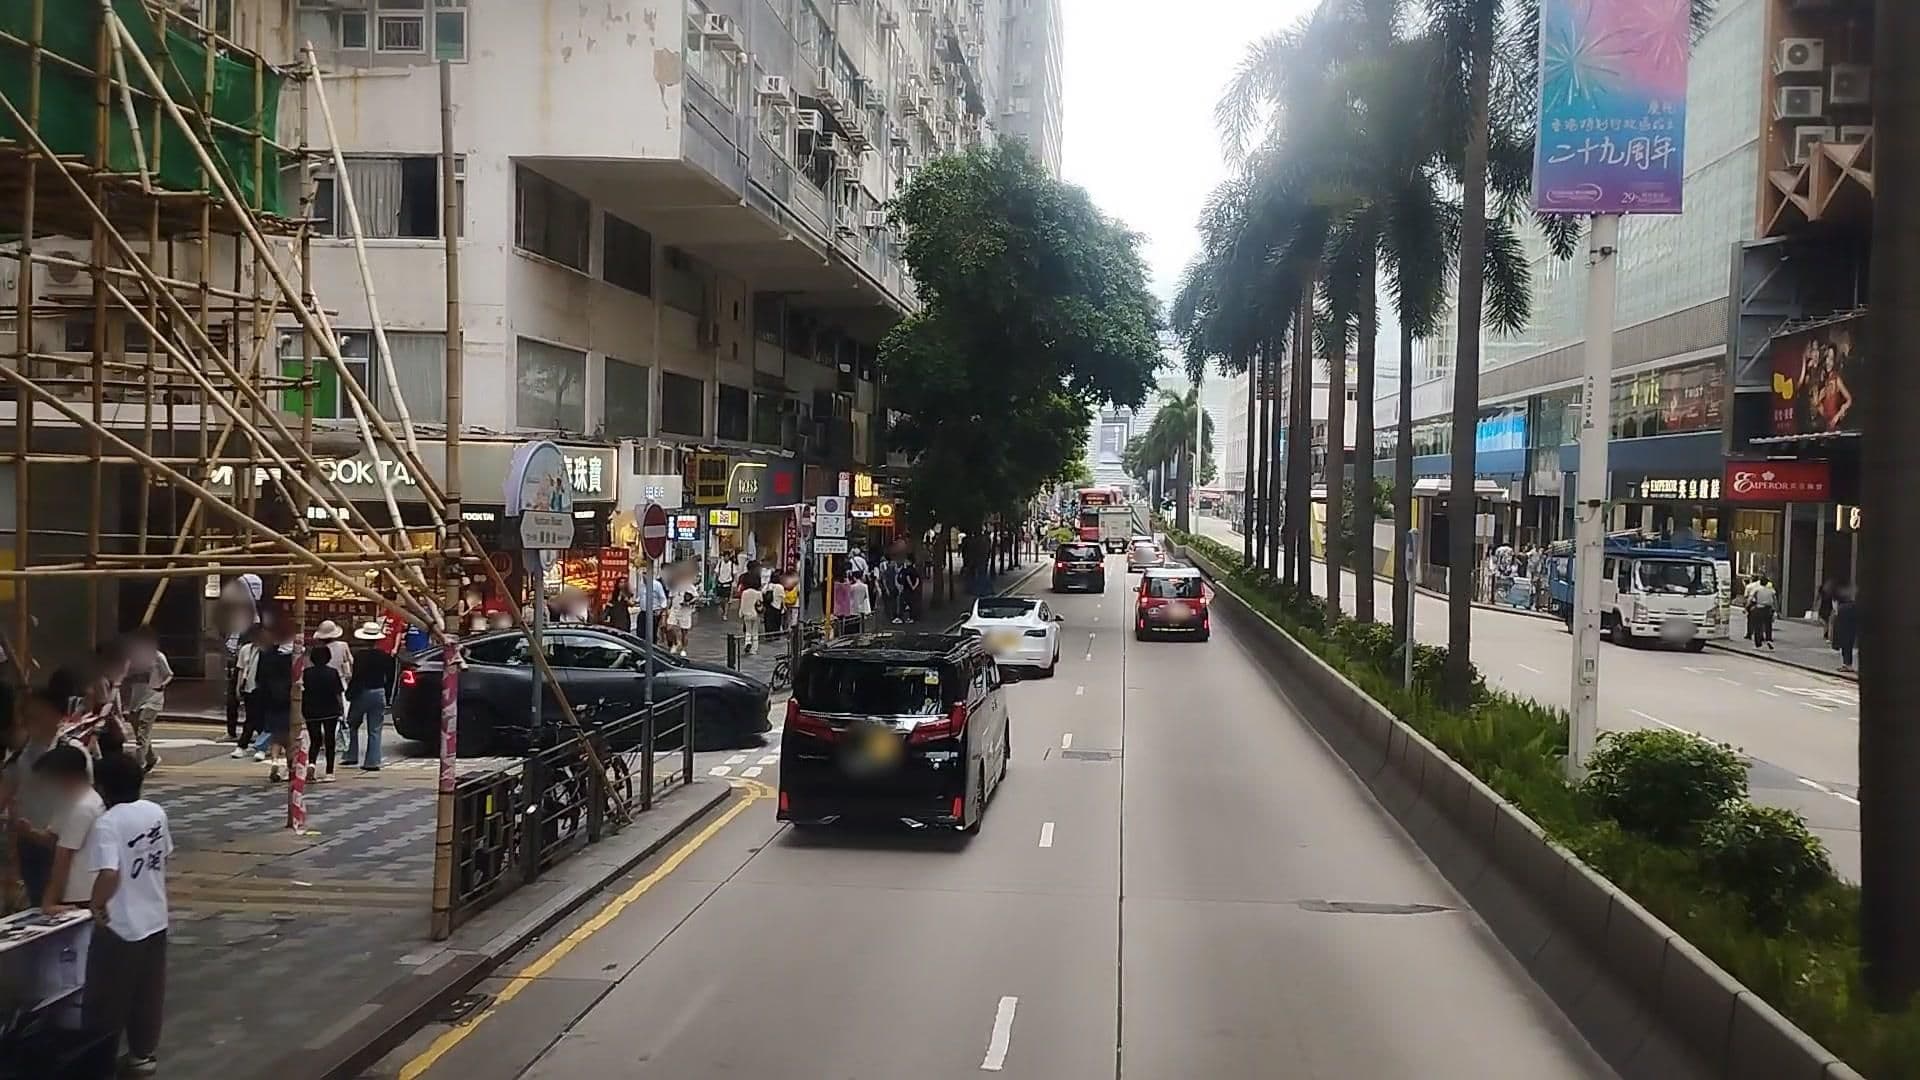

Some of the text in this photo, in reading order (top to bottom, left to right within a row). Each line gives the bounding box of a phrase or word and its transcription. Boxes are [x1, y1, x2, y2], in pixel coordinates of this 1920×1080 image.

[1547, 134, 1677, 171] 二十九周年
[319, 459, 416, 485] OOK TA
[1734, 471, 1788, 493] EMPEROR
